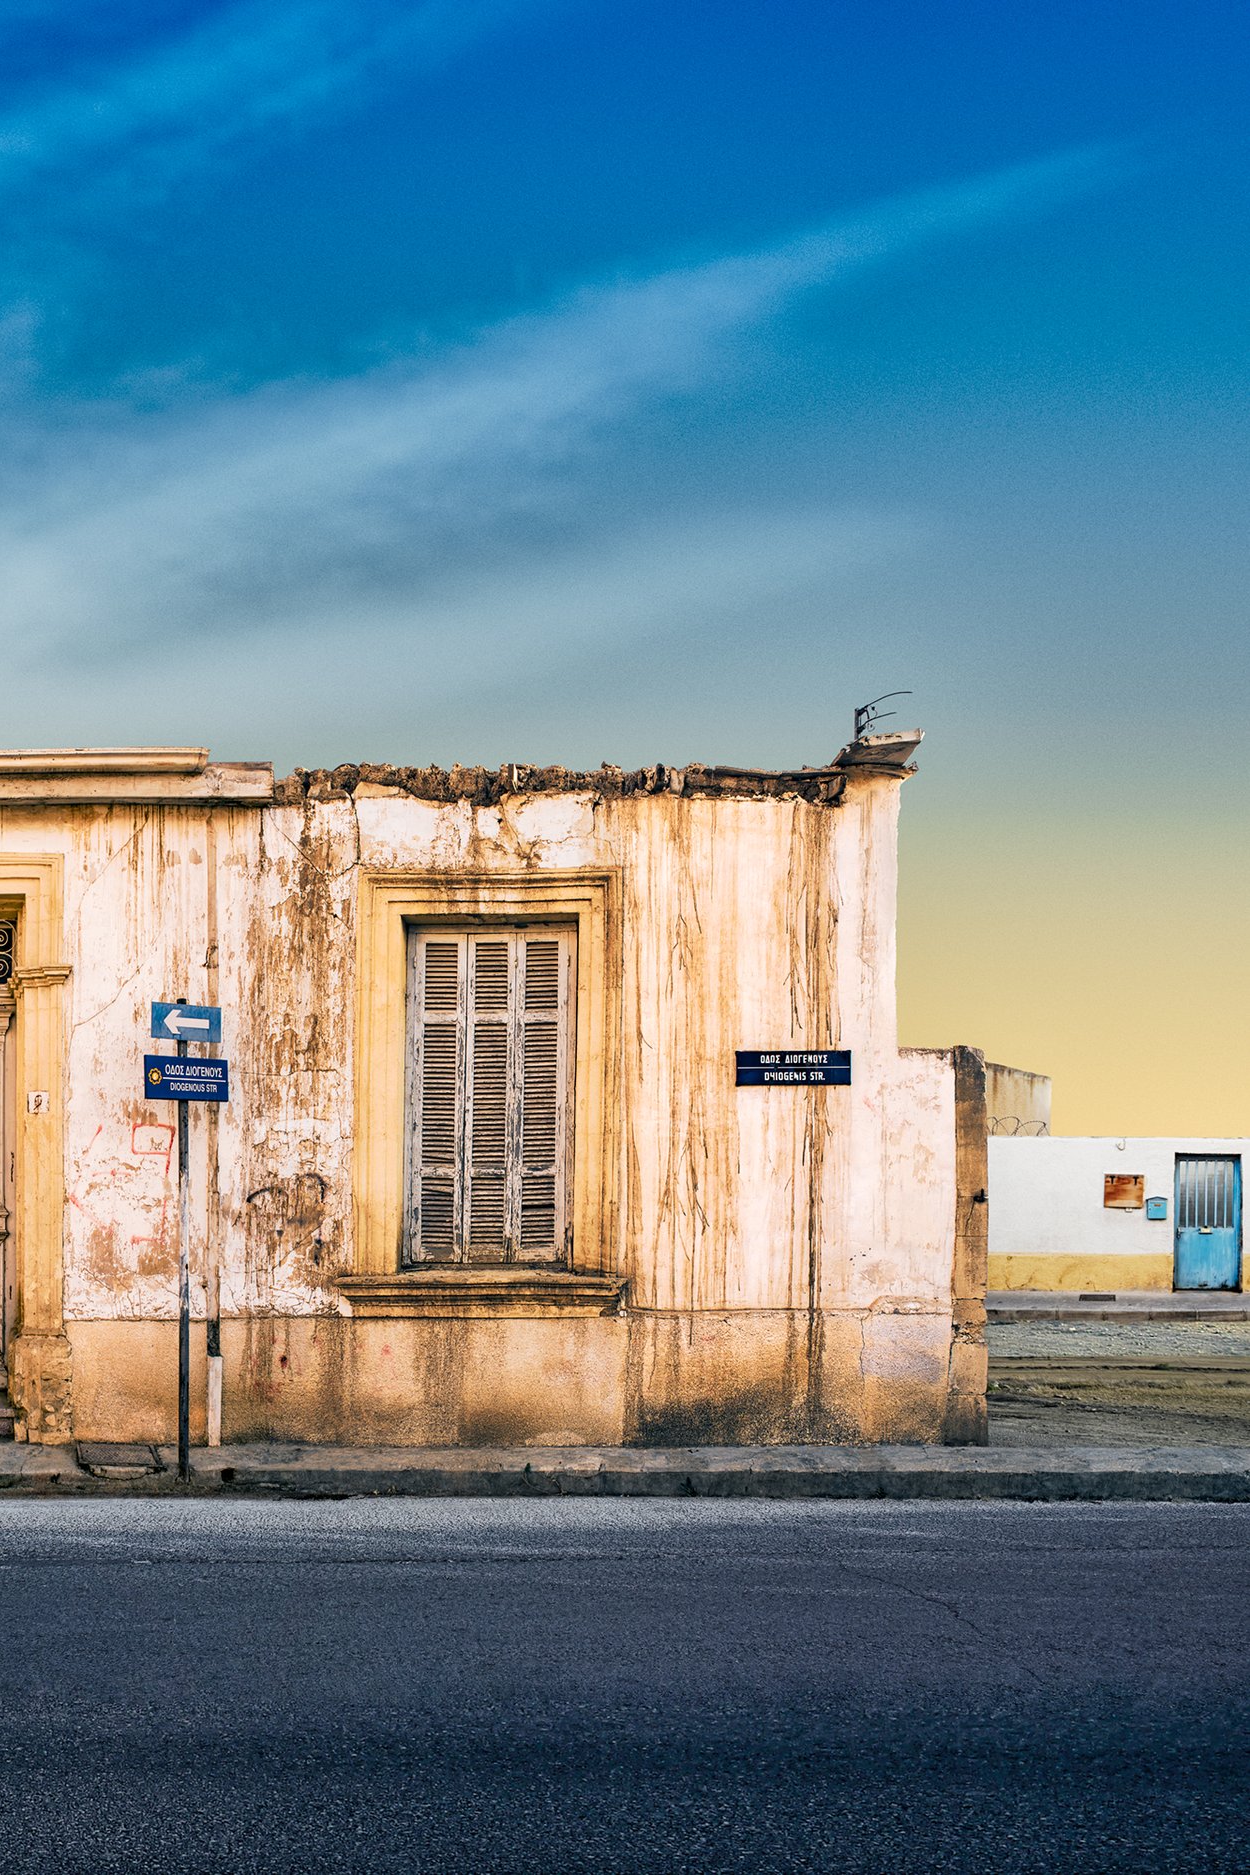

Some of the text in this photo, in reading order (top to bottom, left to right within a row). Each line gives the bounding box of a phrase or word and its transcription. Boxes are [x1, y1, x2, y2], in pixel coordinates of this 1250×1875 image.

[760, 1055, 828, 1064] ΟΔΟΣ ΔΙΟΓΕΝΟΥΣ
[165, 1064, 223, 1078] ΟΔΟΣ ΔΙΟΓΕΝΟΥΣ
[810, 1072, 826, 1081] STR.
[170, 1082, 218, 1093] DIOGENOUS STR
